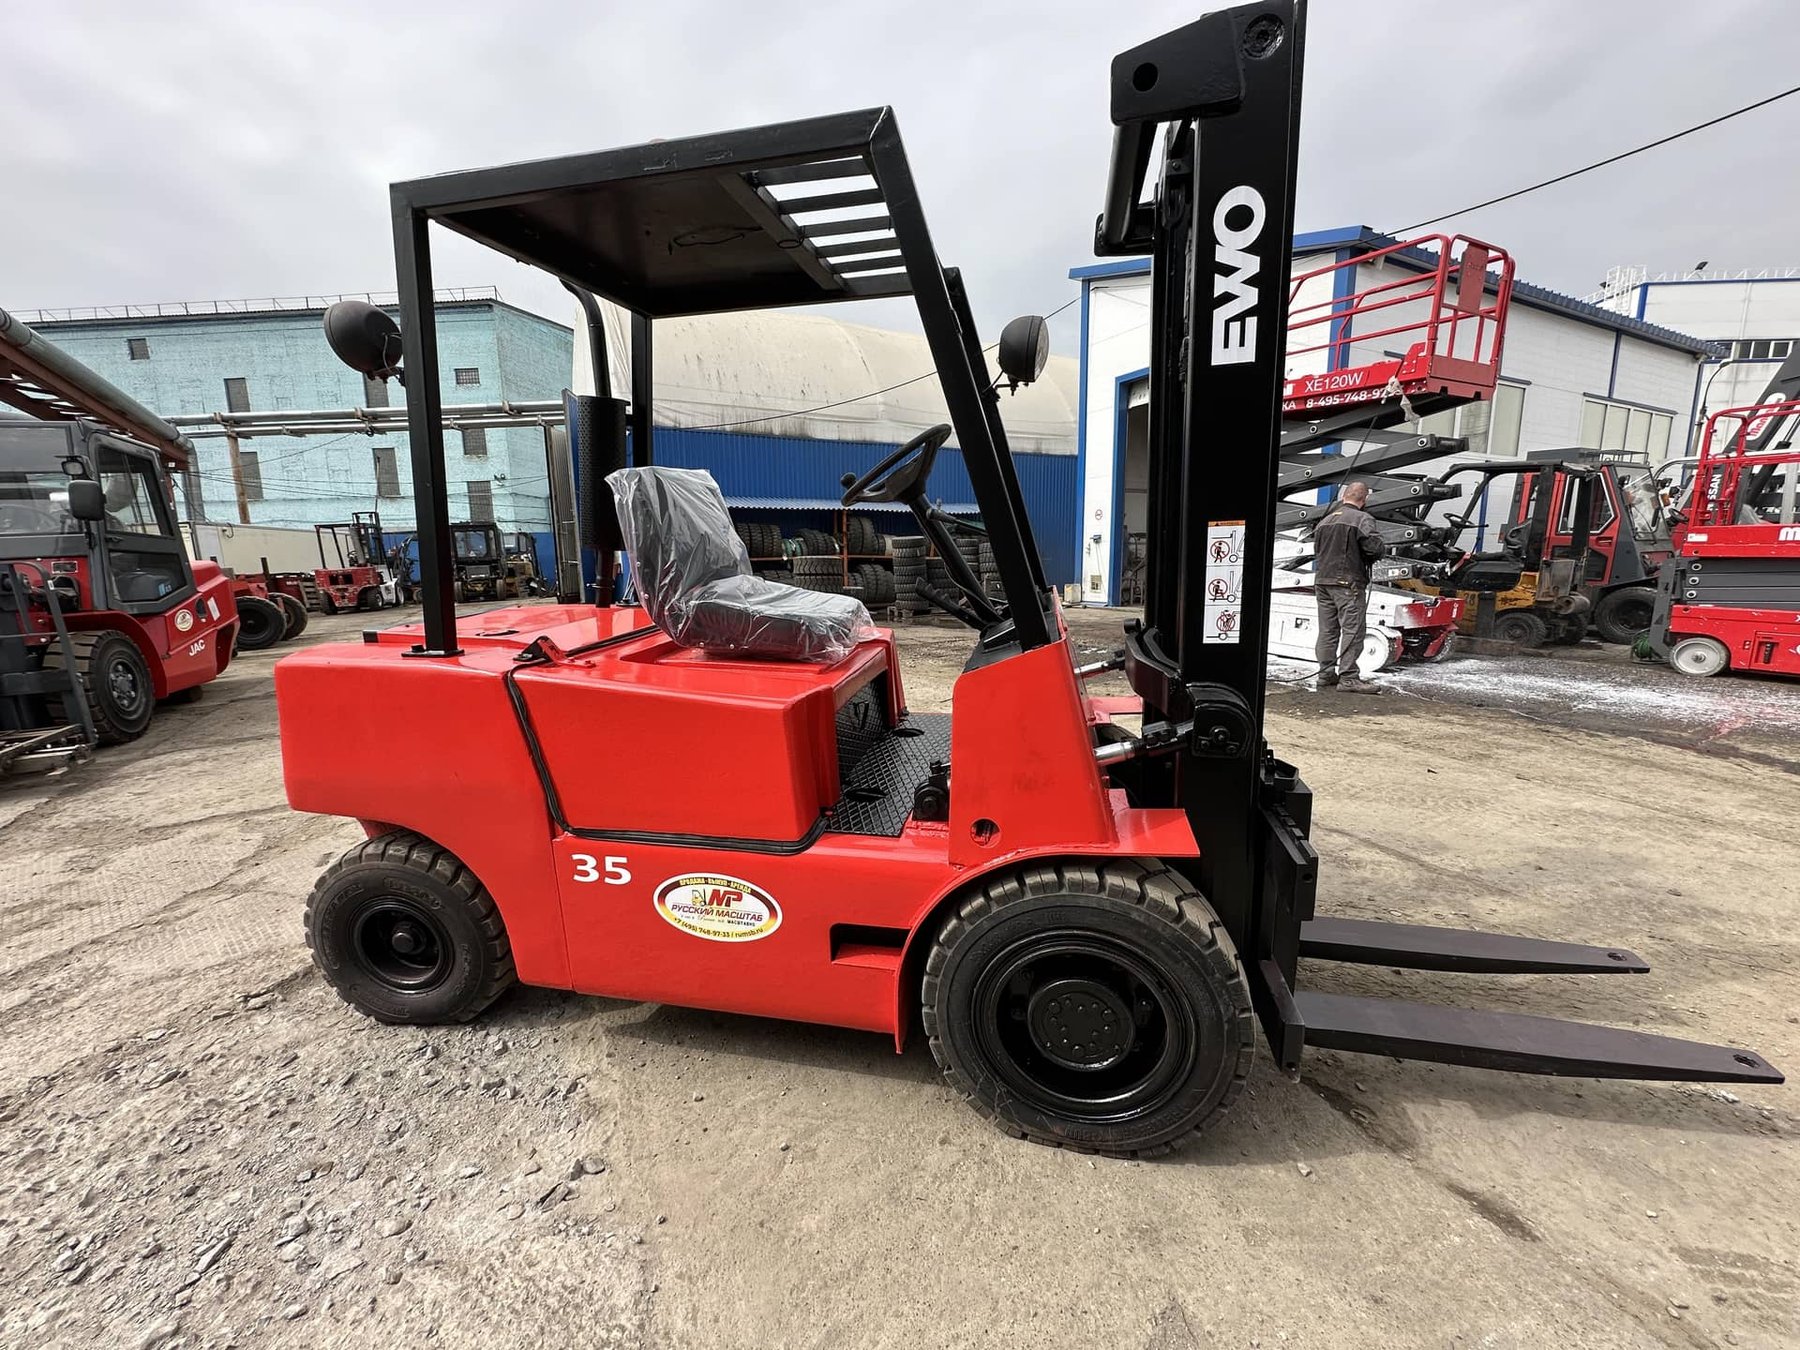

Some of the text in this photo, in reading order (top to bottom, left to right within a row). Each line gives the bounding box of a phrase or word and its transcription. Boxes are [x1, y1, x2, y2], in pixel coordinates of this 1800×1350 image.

[1211, 185, 1266, 366] EWO
[1304, 371, 1364, 393] XE120W
[1706, 473, 1722, 511] NSSAN
[189, 639, 206, 656] JAC
[571, 853, 632, 885] 35
[671, 904, 714, 916] РУССКИЙ
[715, 909, 763, 922] МАСШТАБ
